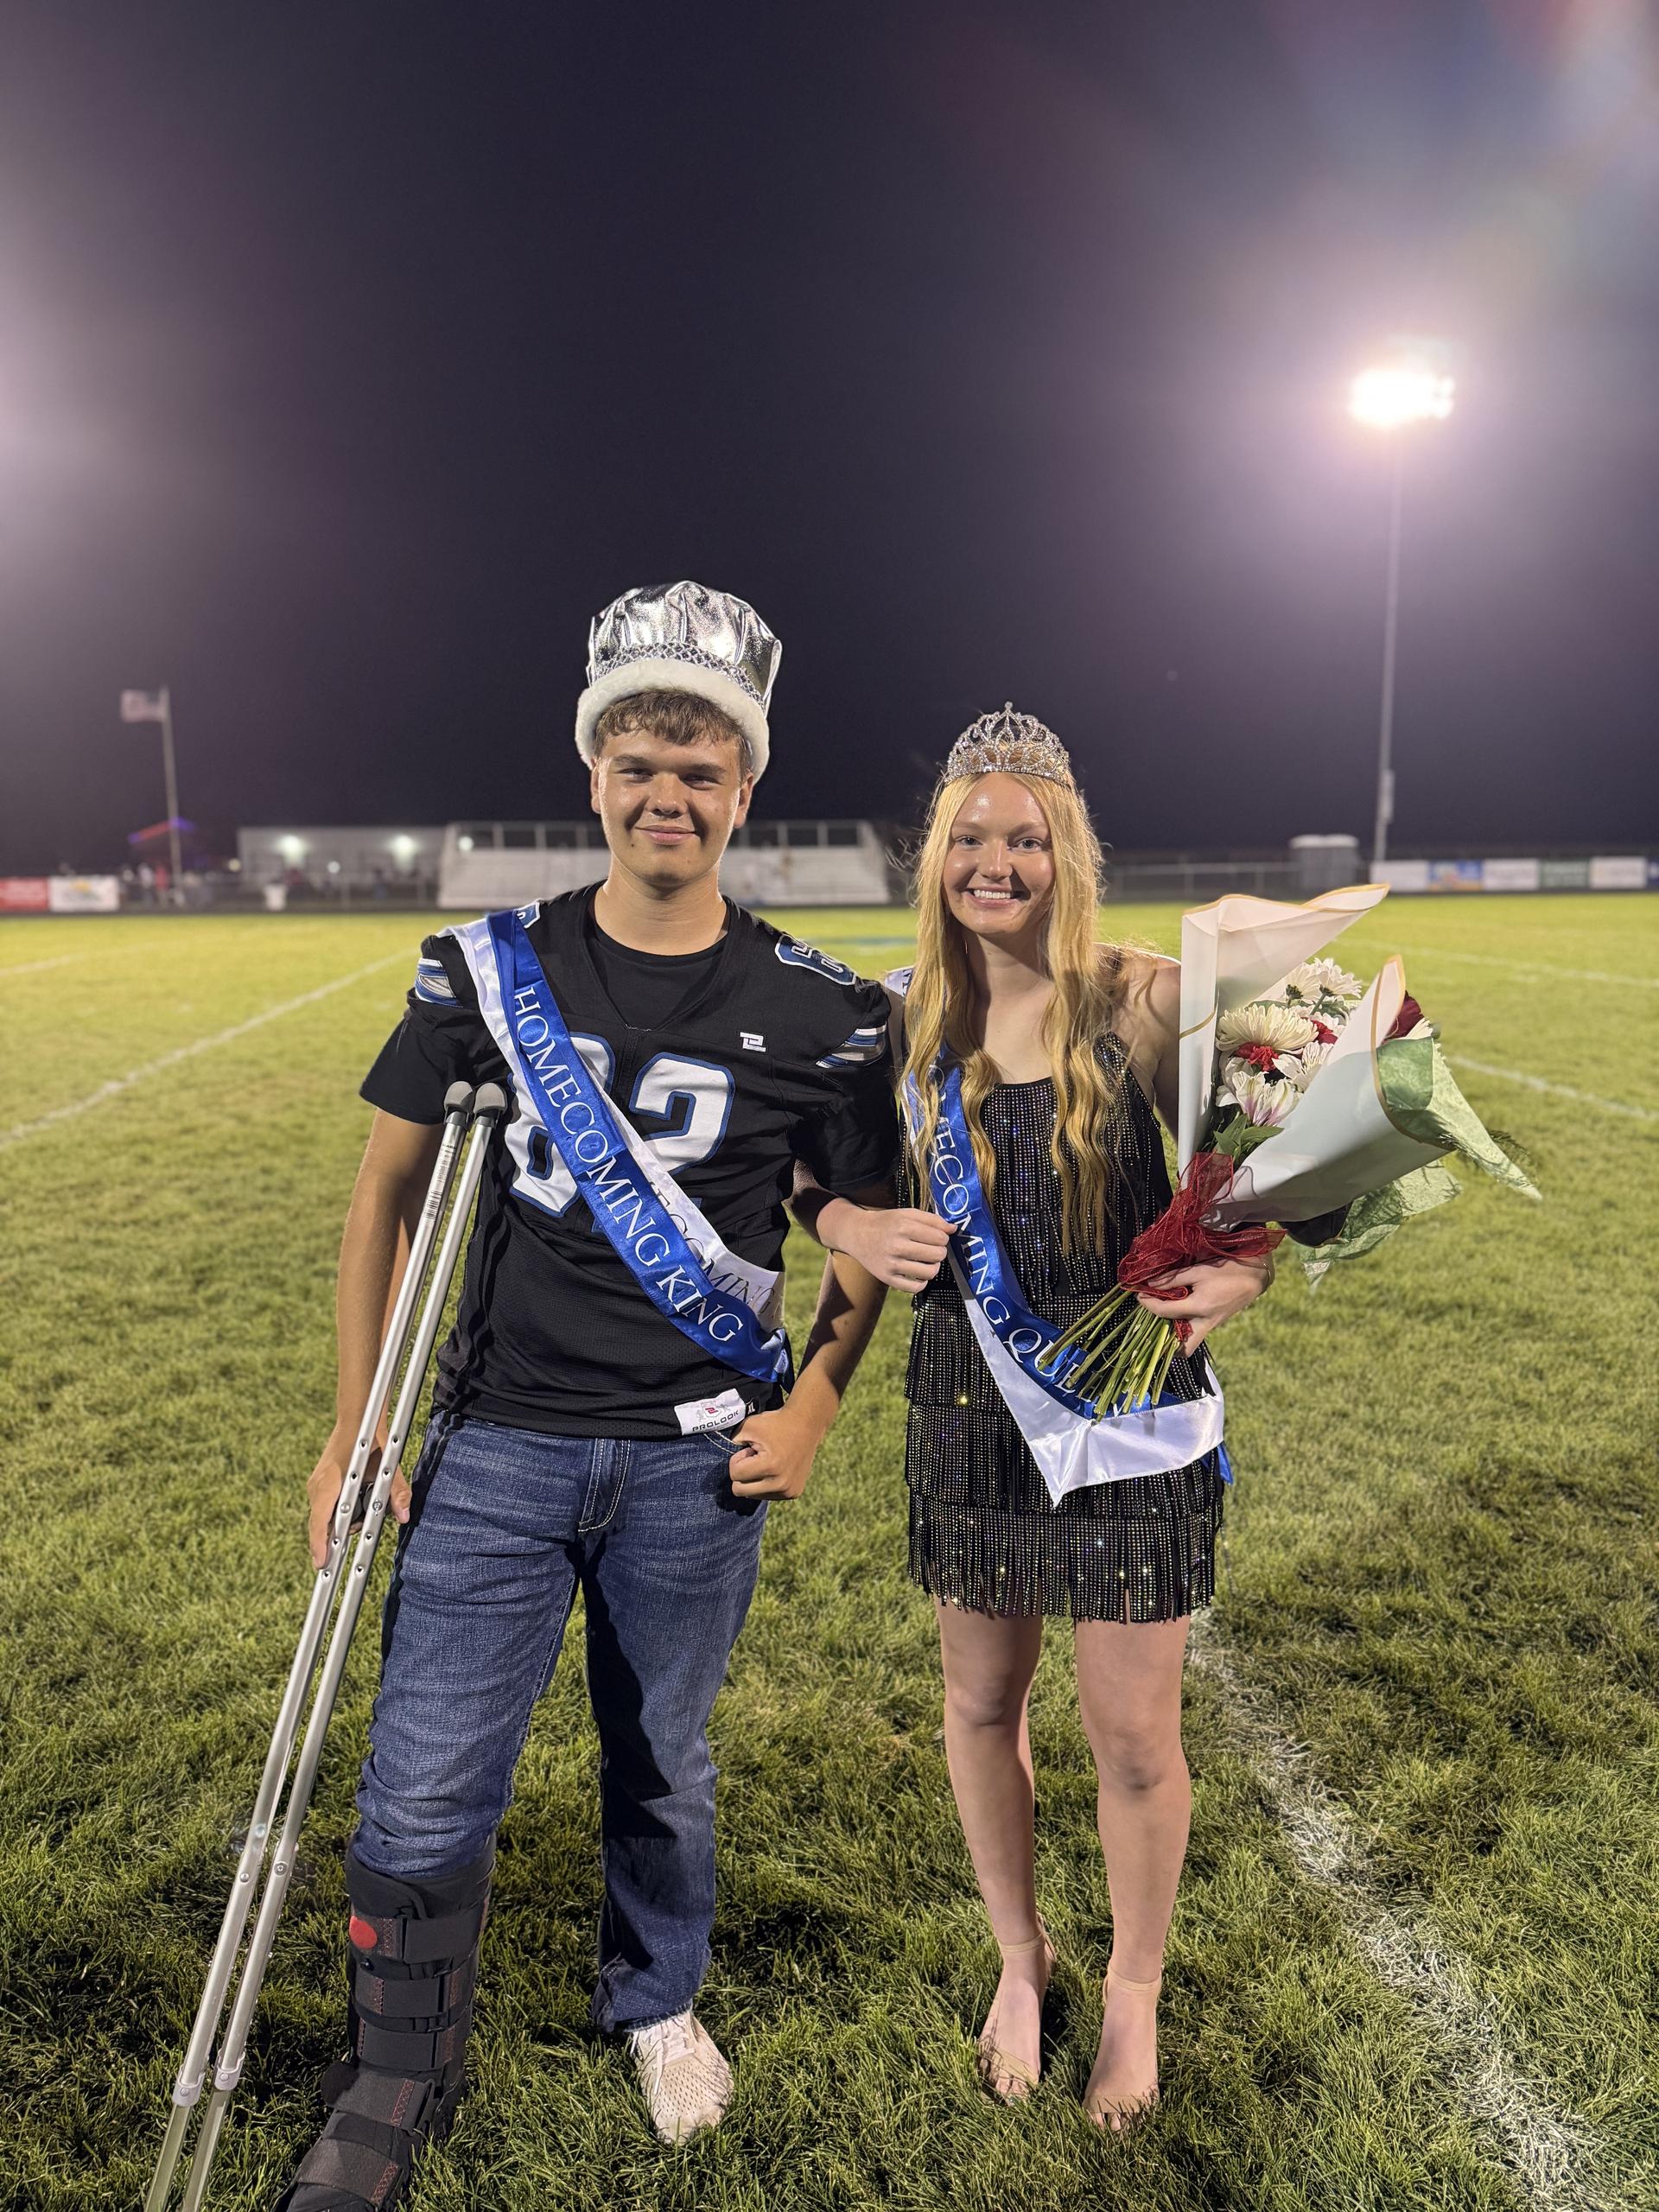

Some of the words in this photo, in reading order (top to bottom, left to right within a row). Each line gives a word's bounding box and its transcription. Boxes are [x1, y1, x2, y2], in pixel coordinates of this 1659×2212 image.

[515, 986, 671, 1267] HOMECOMING
[655, 1264, 745, 1342] KING
[692, 1410, 739, 1432] PROLOOK
